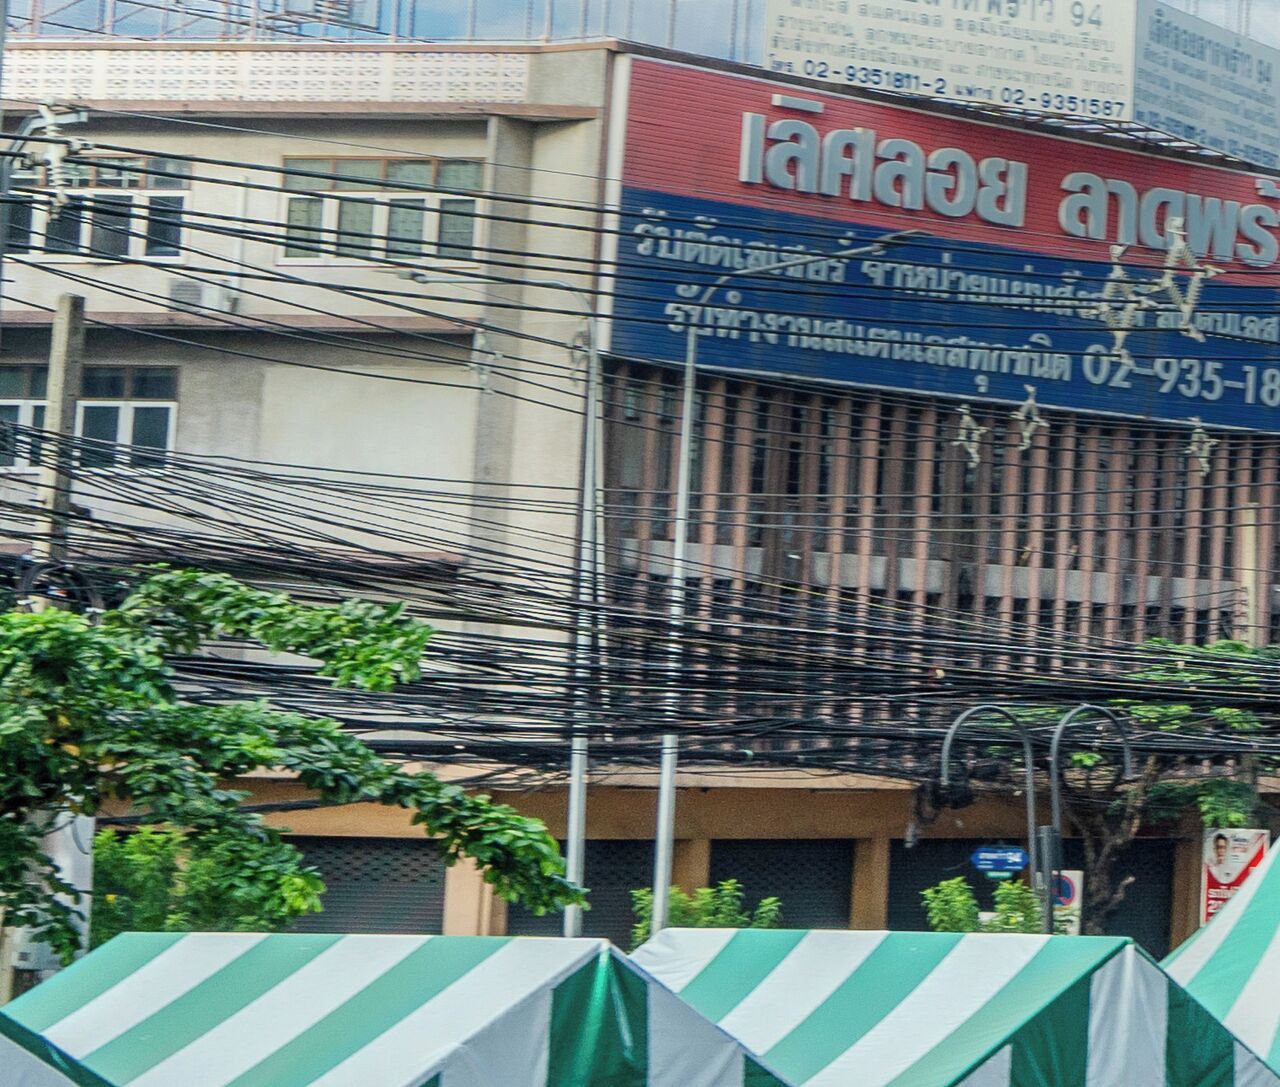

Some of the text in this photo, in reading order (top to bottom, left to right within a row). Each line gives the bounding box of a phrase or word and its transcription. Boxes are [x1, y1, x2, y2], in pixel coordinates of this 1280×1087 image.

[1070, 0, 1104, 32] 94
[804, 59, 946, 94] 02-9351811-2
[1001, 87, 1126, 117] 02-9351587
[740, 93, 1027, 227] เลิศลอย
